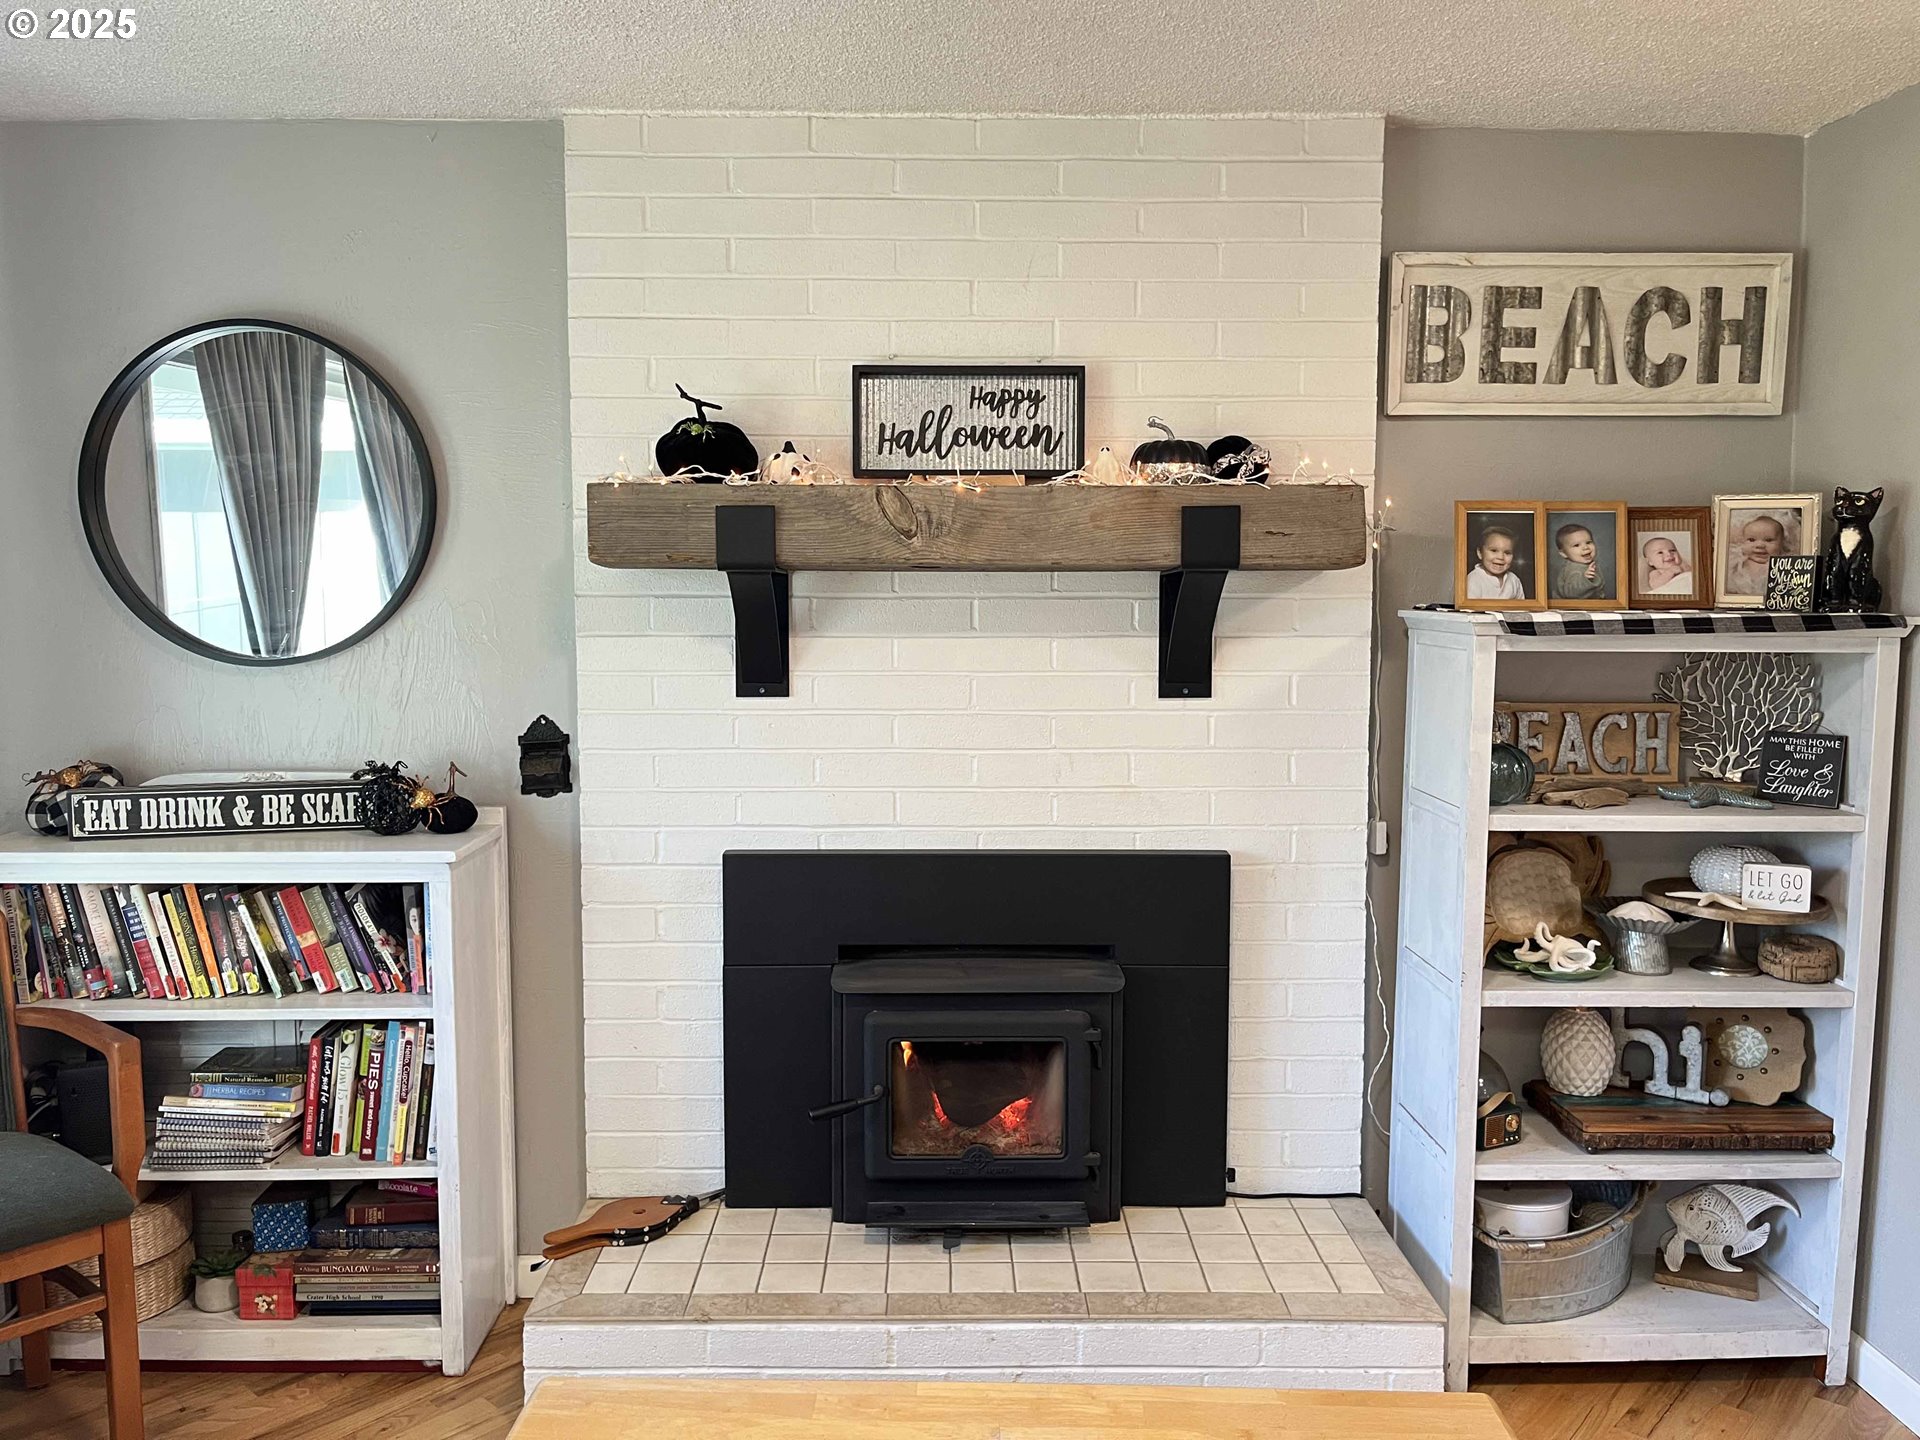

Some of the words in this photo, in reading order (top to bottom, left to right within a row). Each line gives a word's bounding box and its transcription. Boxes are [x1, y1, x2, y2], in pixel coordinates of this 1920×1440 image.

[1404, 285, 1768, 388] BEACH
[969, 385, 1047, 420] Happy
[877, 404, 1064, 461] Halloween
[1794, 557, 1814, 570] are
[1791, 570, 1812, 589] Sun
[1767, 592, 1810, 610] Shine
[1497, 710, 1672, 775] EACH
[1769, 736, 1788, 744] MAY
[1788, 737, 1807, 746] THIS
[1808, 738, 1841, 749] HOME
[1784, 744, 1796, 752] BE
[1796, 746, 1824, 755] FILLED
[1793, 752, 1816, 761] WITH
[1767, 759, 1809, 778] Love
[1813, 763, 1834, 786] &
[1762, 776, 1834, 802] Laughter
[82, 798, 132, 832] EAT
[139, 795, 226, 830] DRINK
[233, 794, 254, 827] &
[261, 794, 296, 824] BE
[1749, 870, 1774, 887] LET
[1780, 873, 1803, 890] GO
[87, 890, 102, 920] SMOKE
[1757, 890, 1776, 901] let
[1778, 890, 1804, 905] God
[312, 889, 321, 901] THE
[317, 903, 333, 931] SUMMER
[69, 914, 77, 930] SOUL
[92, 922, 109, 955] JUMPER
[403, 1044, 412, 1065] Hello,
[367, 1052, 381, 1090] PIES
[213, 1087, 238, 1095] HERBAL
[239, 1088, 266, 1096] RECIPES
[400, 1066, 410, 1099] Cupcake!
[368, 1091, 376, 1108] sweet
[305, 1124, 314, 1140] HOLLIS
[365, 1120, 374, 1140] savory
[321, 1265, 371, 1273] BUNGALOW
